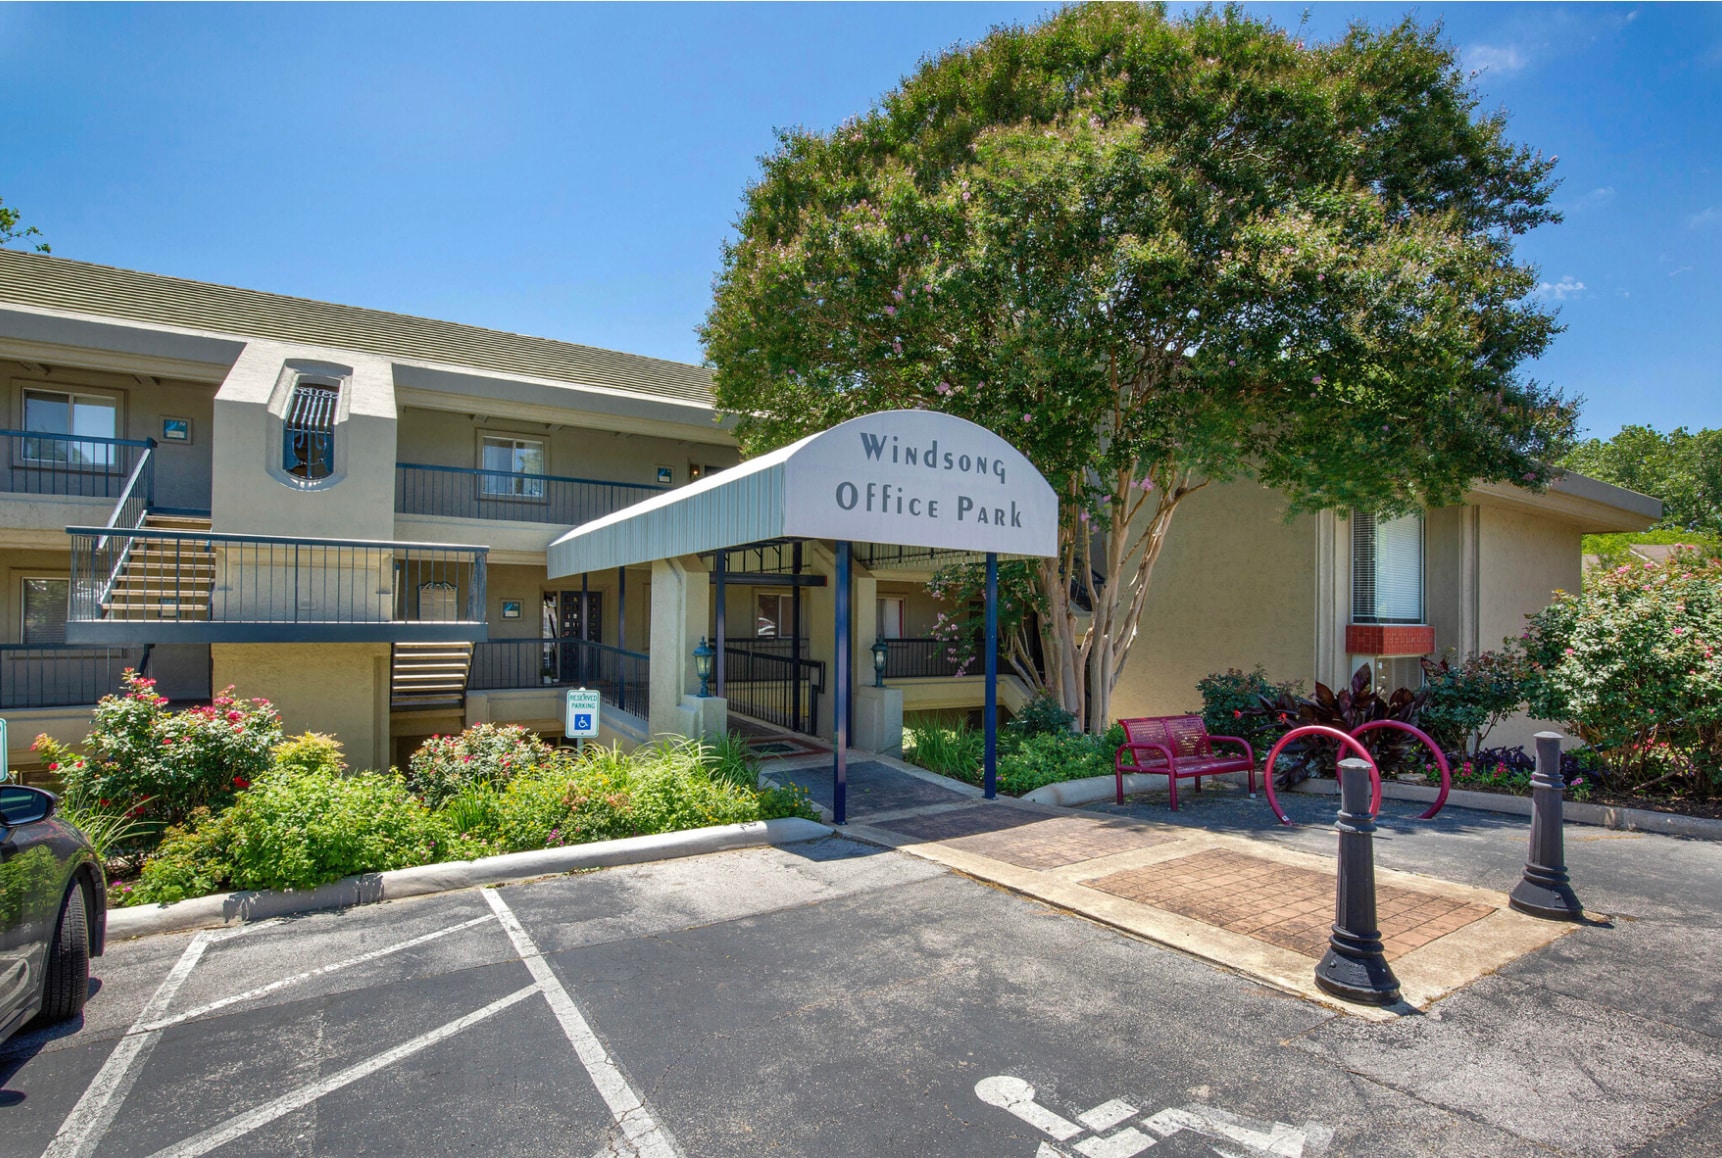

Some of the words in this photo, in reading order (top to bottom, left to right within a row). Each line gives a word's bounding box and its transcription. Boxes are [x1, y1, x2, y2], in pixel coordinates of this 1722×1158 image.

[860, 432, 1006, 484] Windsong
[835, 481, 939, 518] Office
[957, 495, 1022, 528] Park
